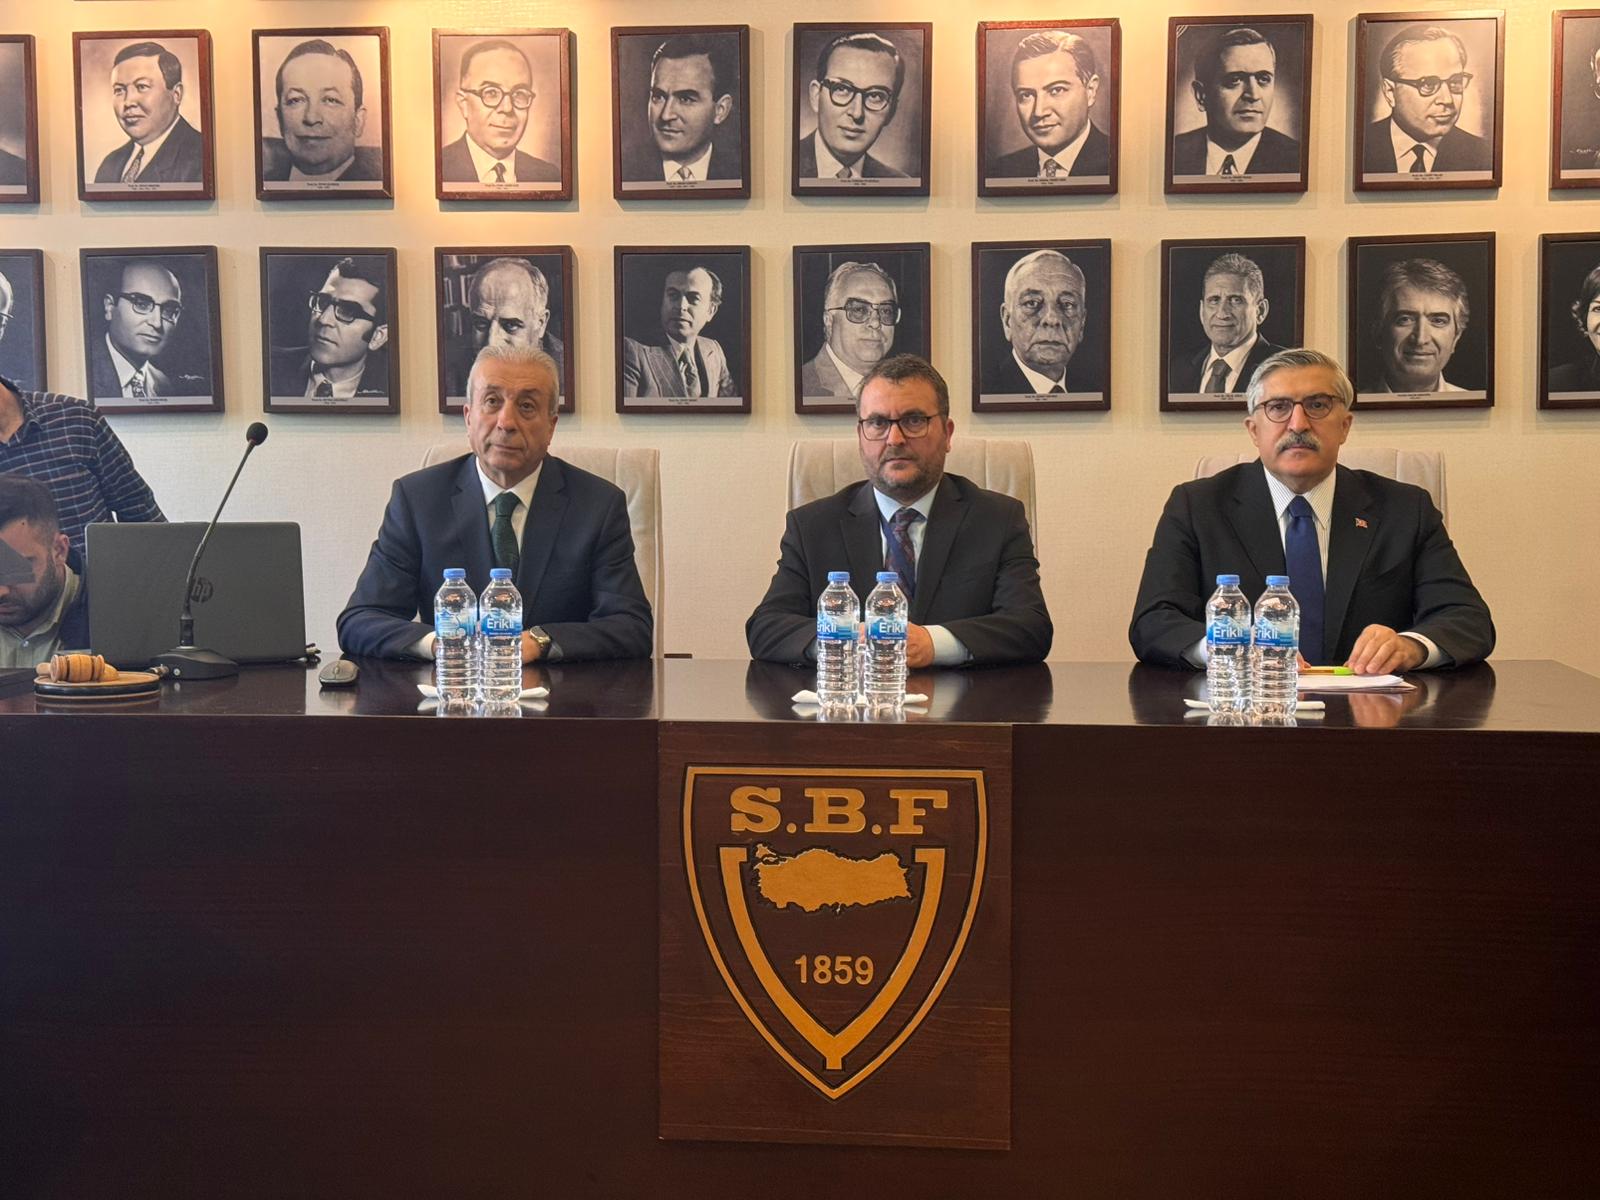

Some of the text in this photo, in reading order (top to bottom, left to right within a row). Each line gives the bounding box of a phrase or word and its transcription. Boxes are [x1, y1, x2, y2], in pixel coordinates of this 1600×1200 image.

[1213, 626, 1243, 638] Erikli
[731, 786, 948, 834] S.B.F
[794, 955, 874, 985] 1859
